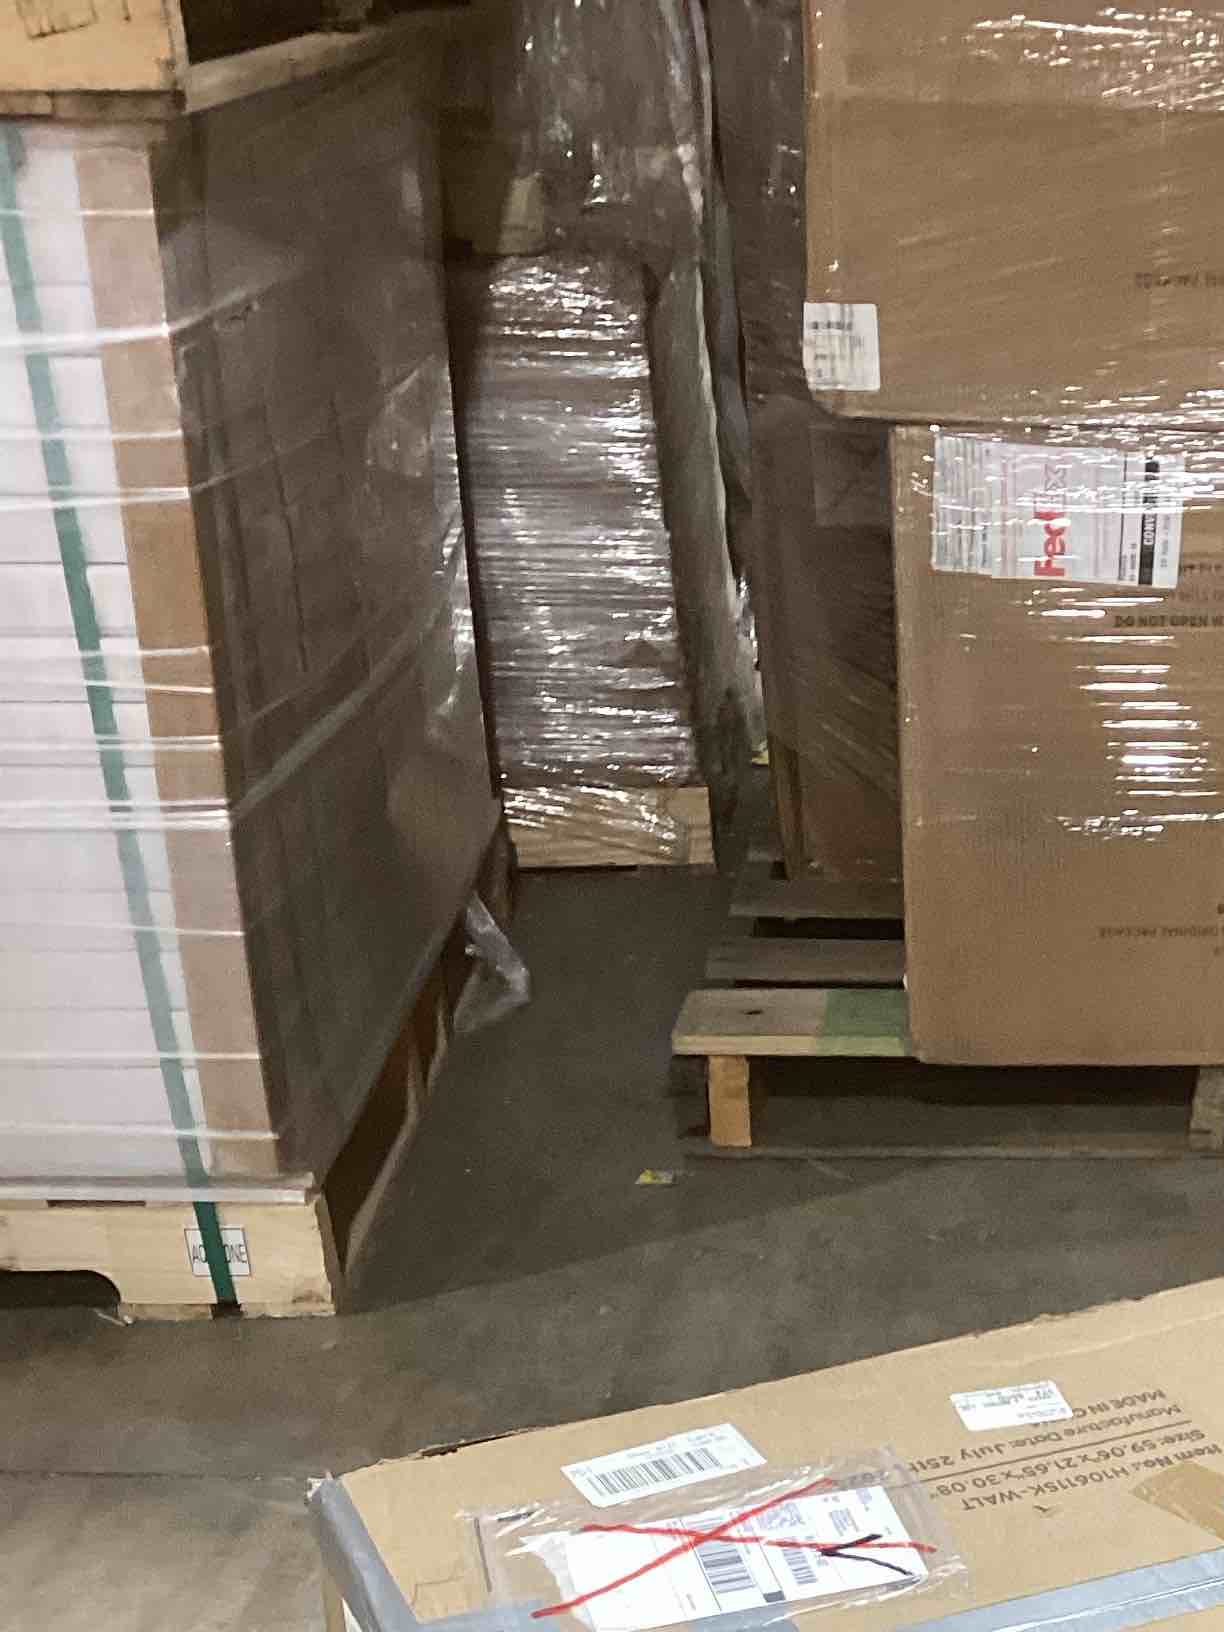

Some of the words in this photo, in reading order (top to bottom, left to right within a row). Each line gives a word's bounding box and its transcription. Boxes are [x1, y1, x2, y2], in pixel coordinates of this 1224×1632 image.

[1115, 1388, 1168, 1412] MADE
[959, 1440, 1008, 1463] July
[1176, 1443, 1223, 1463] Item
